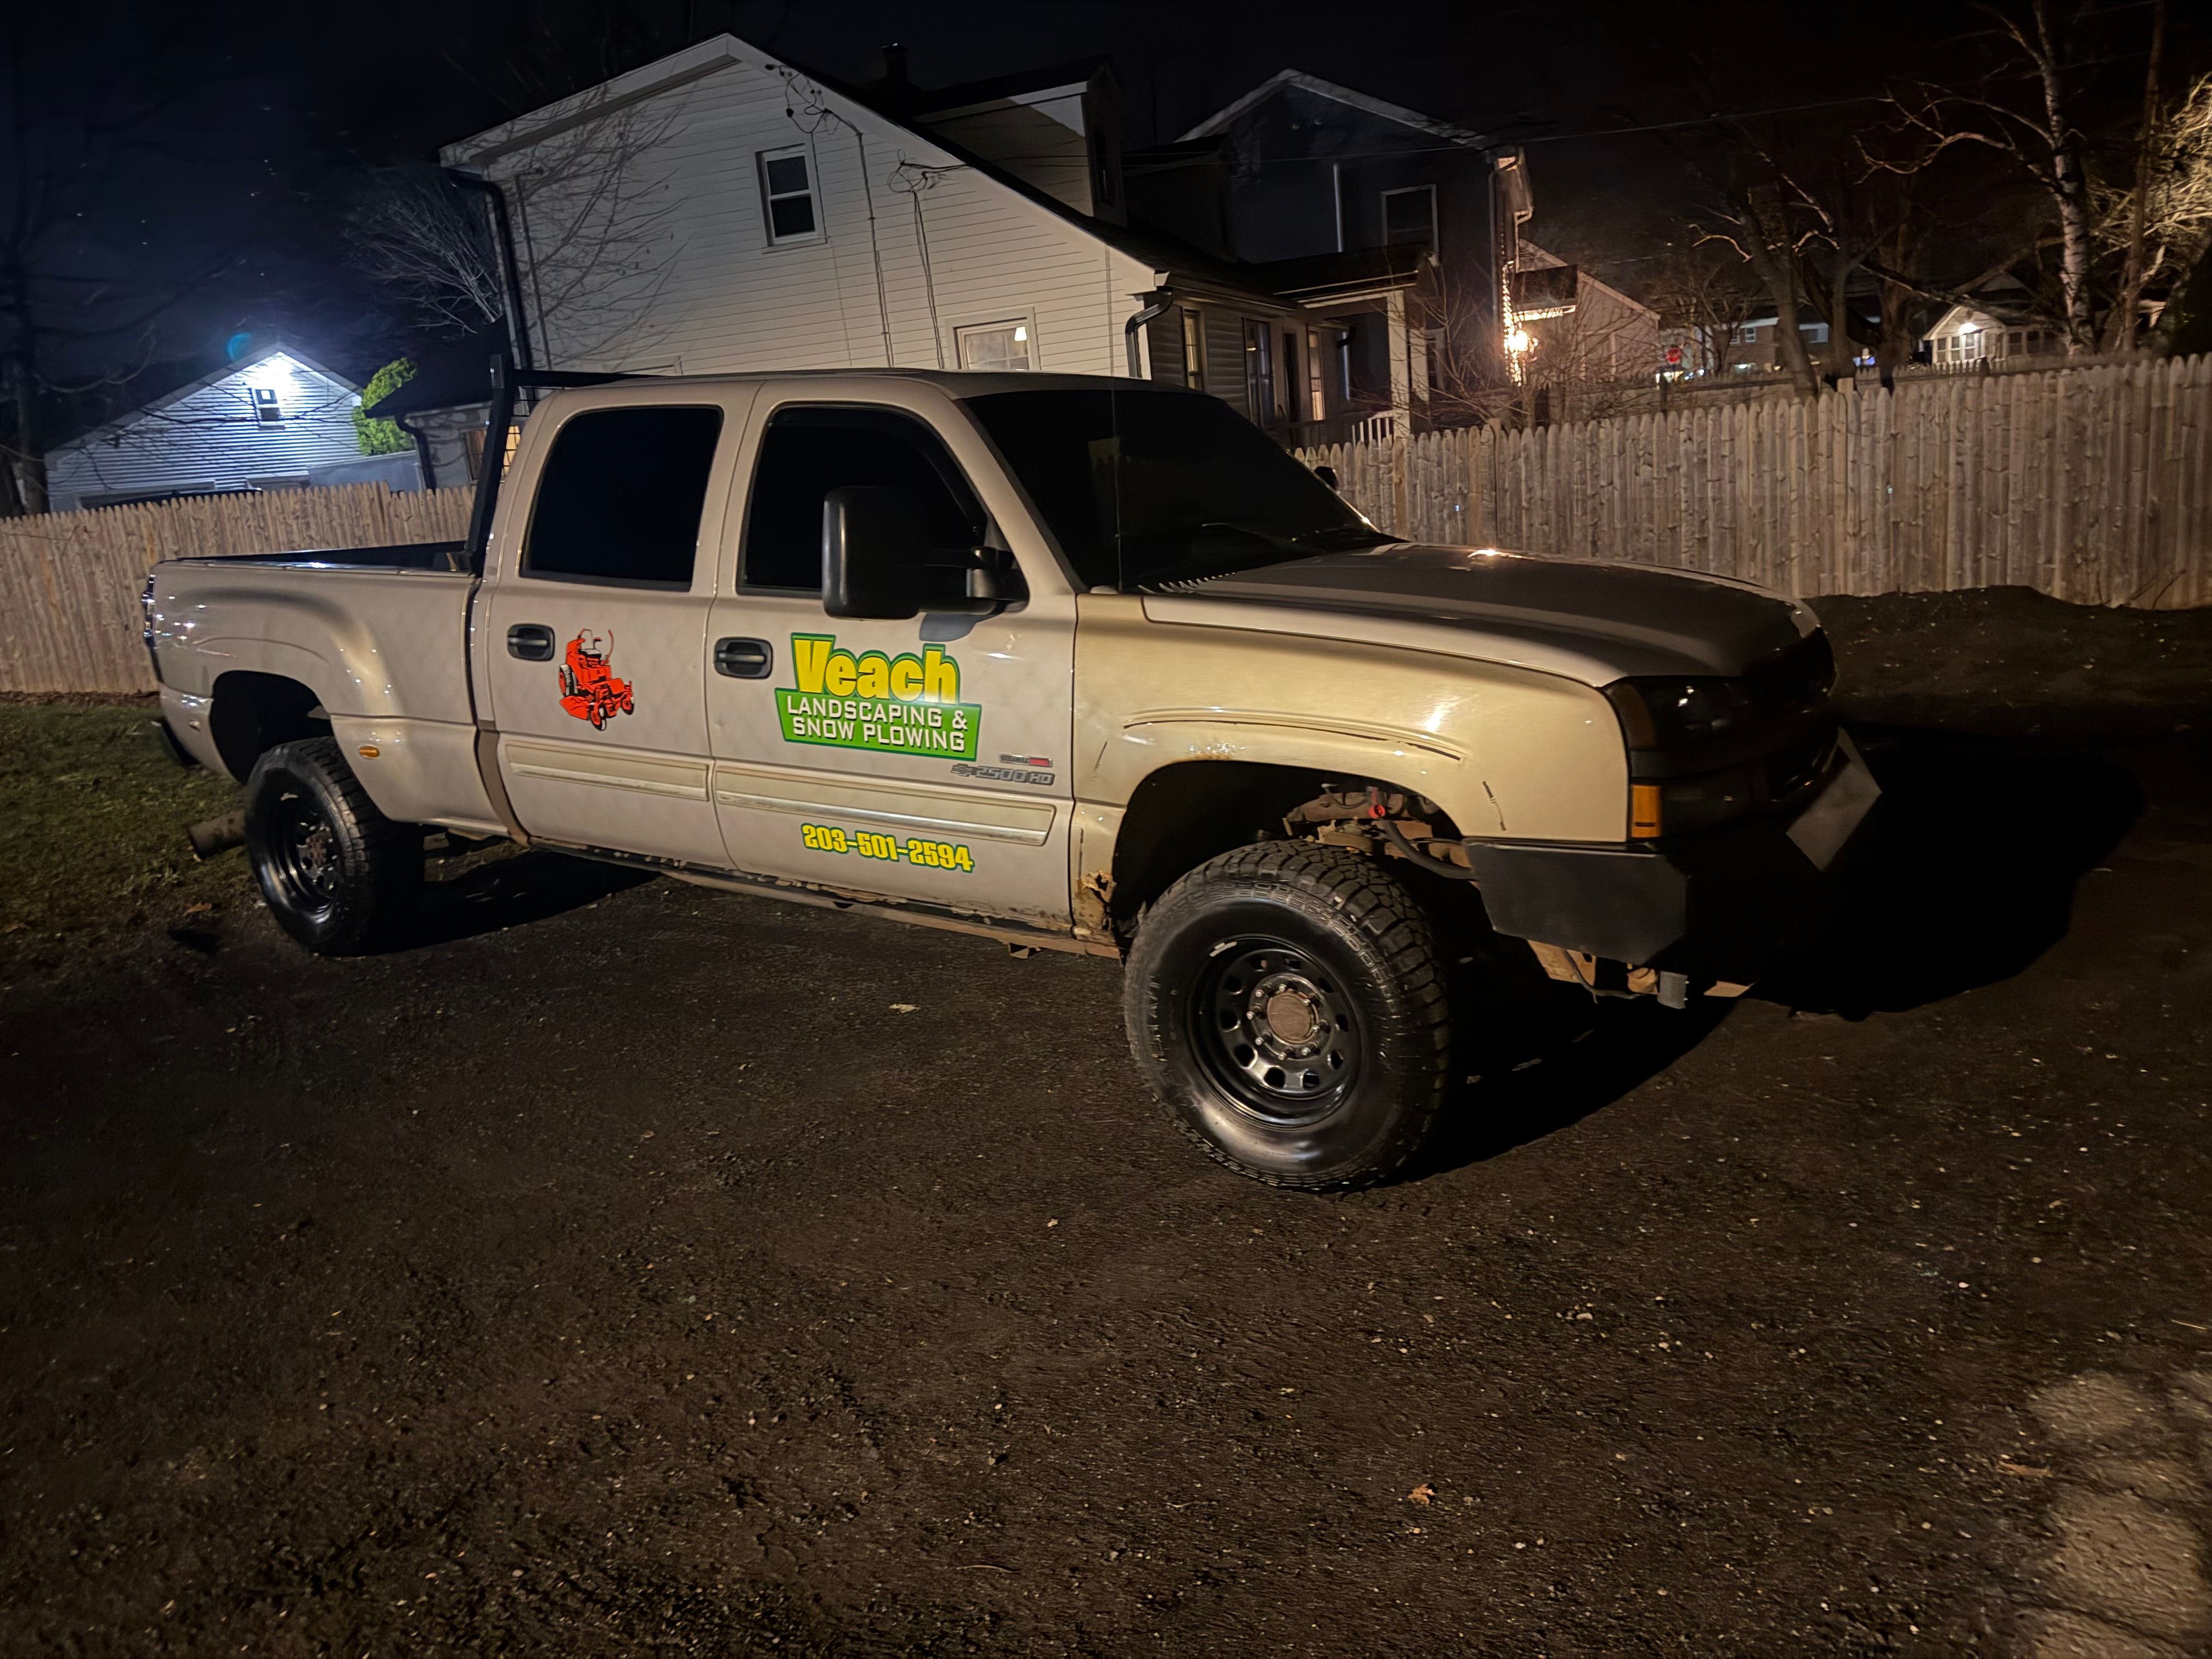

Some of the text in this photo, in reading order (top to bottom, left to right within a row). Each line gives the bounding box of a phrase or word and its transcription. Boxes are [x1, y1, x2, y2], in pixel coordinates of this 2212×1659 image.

[793, 635, 959, 704] Veach
[787, 695, 968, 730] LANDSCAPING &
[793, 717, 964, 752] SNOW PLOWING
[802, 824, 974, 872] 203-501-2594
